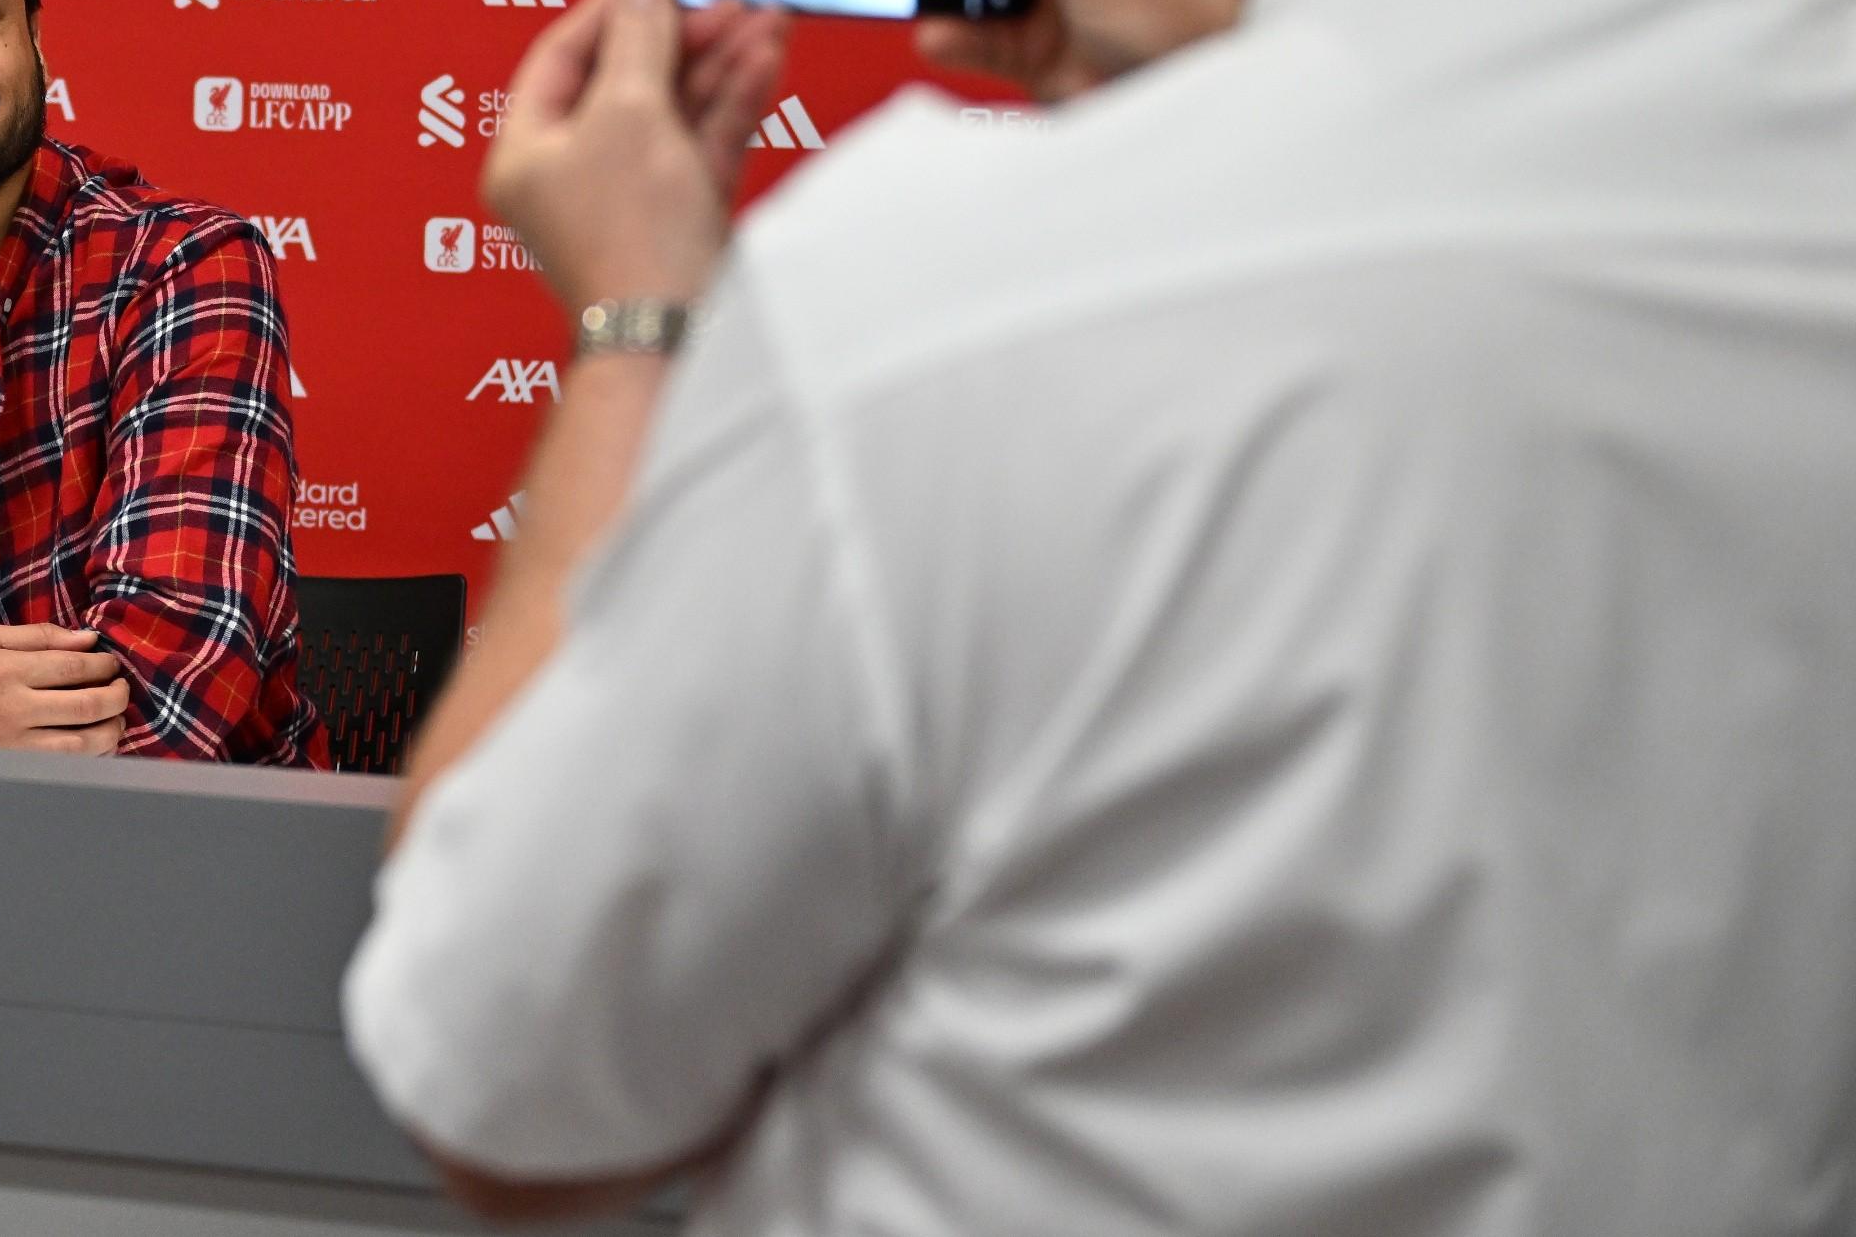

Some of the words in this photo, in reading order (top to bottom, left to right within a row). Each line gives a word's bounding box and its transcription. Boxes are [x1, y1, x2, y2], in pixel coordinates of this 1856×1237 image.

[250, 82, 331, 100] DOWNLOAD
[249, 100, 295, 130] LFC
[299, 100, 352, 131] APP
[465, 358, 561, 403] AXA
